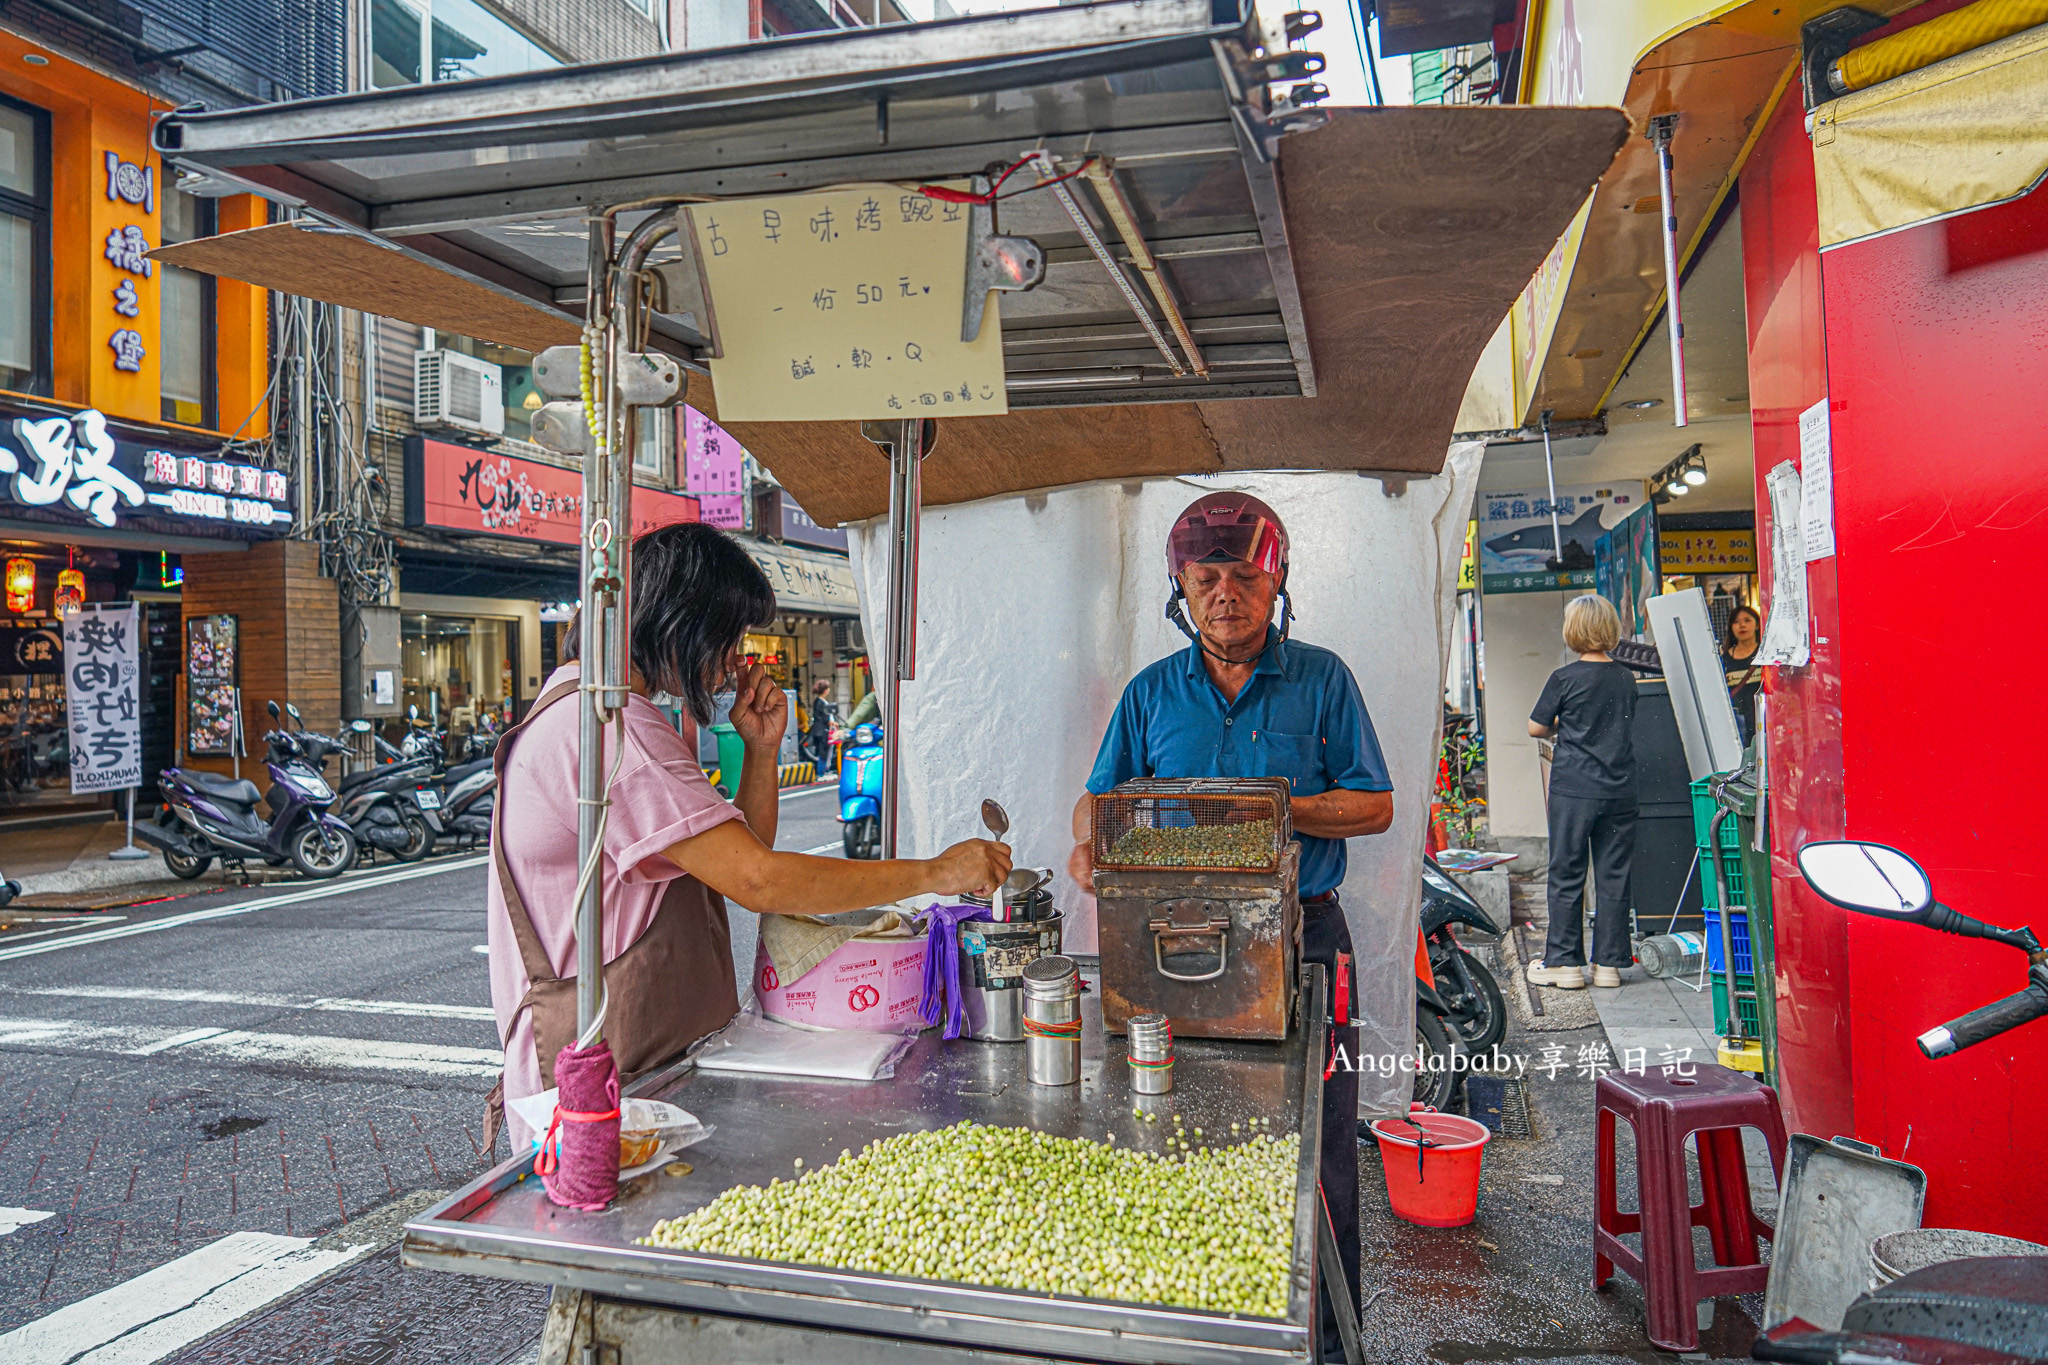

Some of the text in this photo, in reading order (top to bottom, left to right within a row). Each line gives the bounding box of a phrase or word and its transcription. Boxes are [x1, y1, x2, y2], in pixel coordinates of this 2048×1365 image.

[173, 491, 272, 524] SINCE 1999
[1488, 496, 1575, 521] 鯊魚來襲
